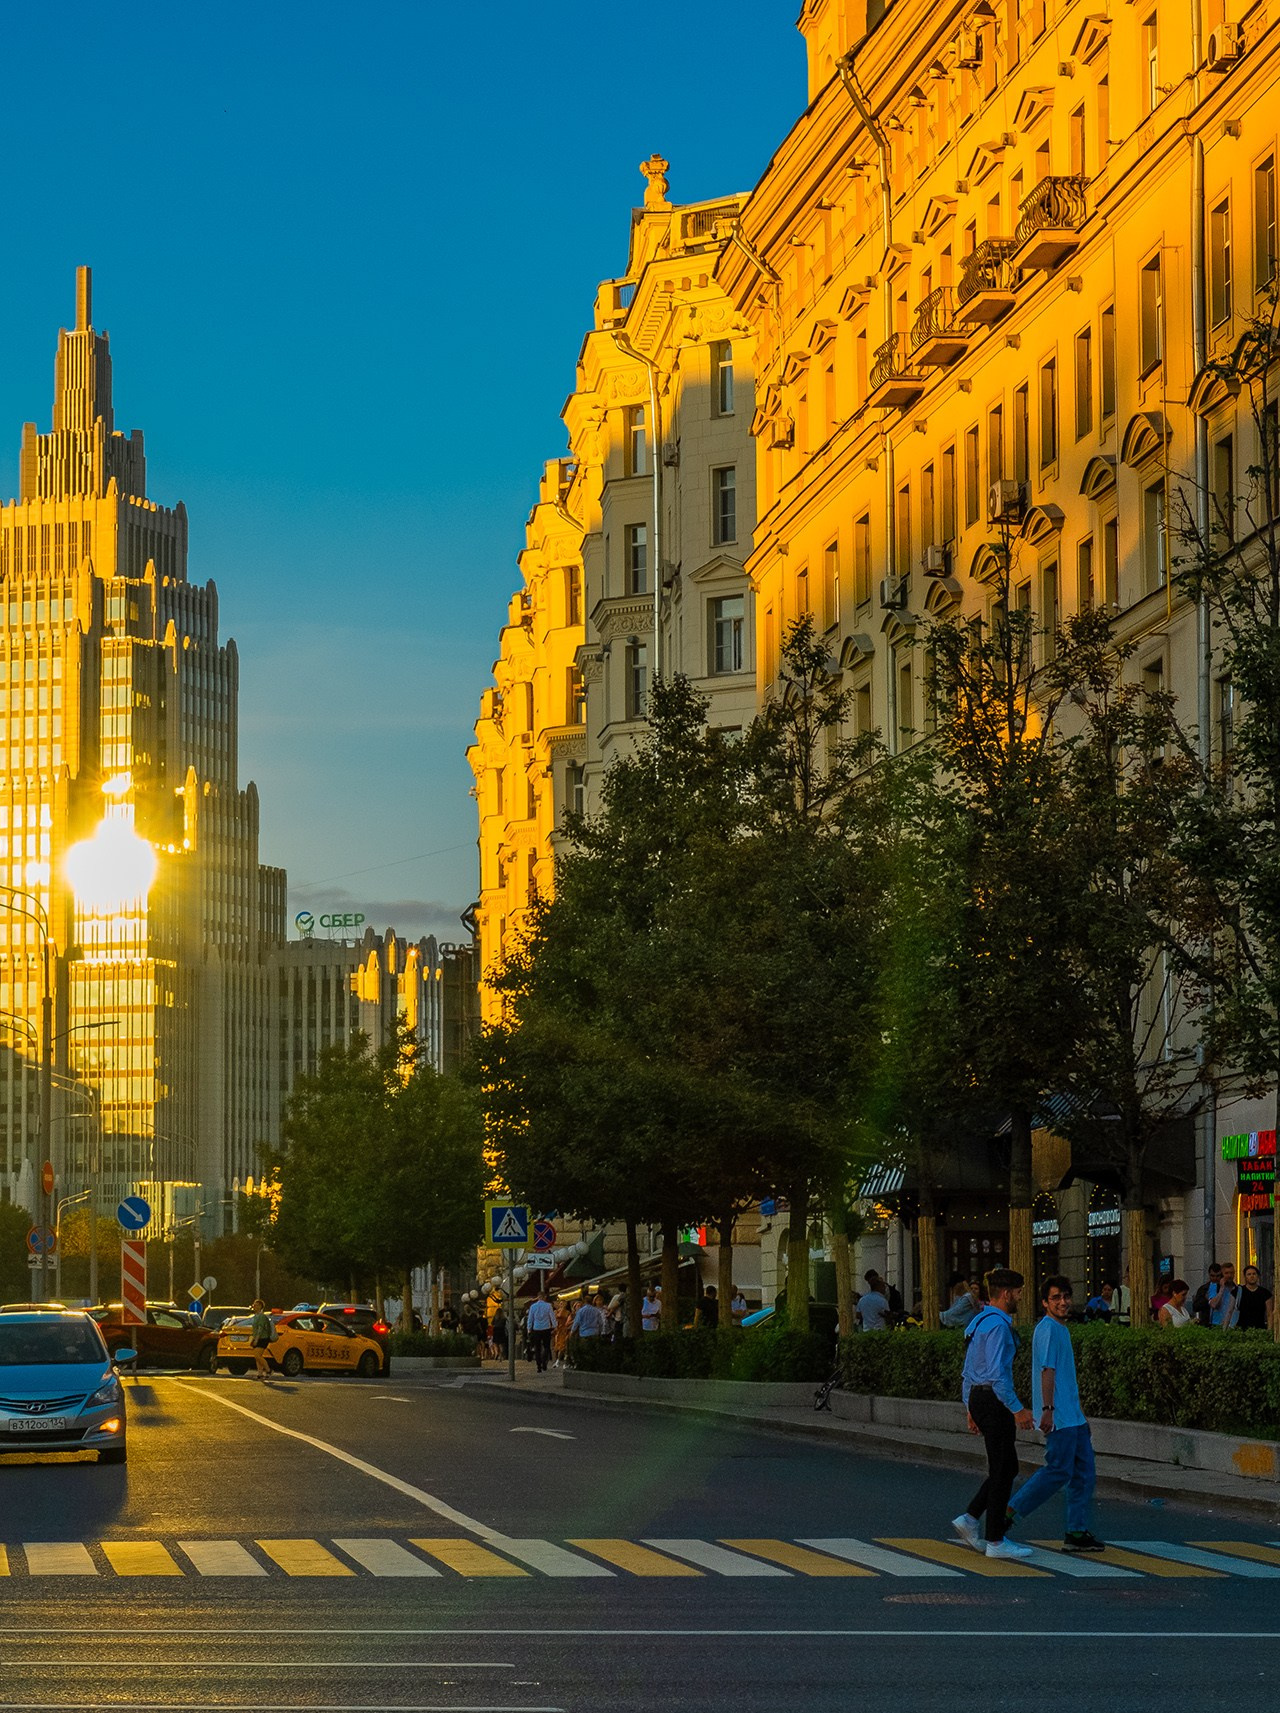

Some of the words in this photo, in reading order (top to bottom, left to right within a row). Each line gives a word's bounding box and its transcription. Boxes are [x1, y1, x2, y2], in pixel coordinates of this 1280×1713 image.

[319, 913, 365, 928] СБЕР
[1241, 1161, 1273, 1171] ТАБАК
[1240, 1172, 1275, 1181] НАПИТКИ
[1252, 1181, 1264, 1192] 24
